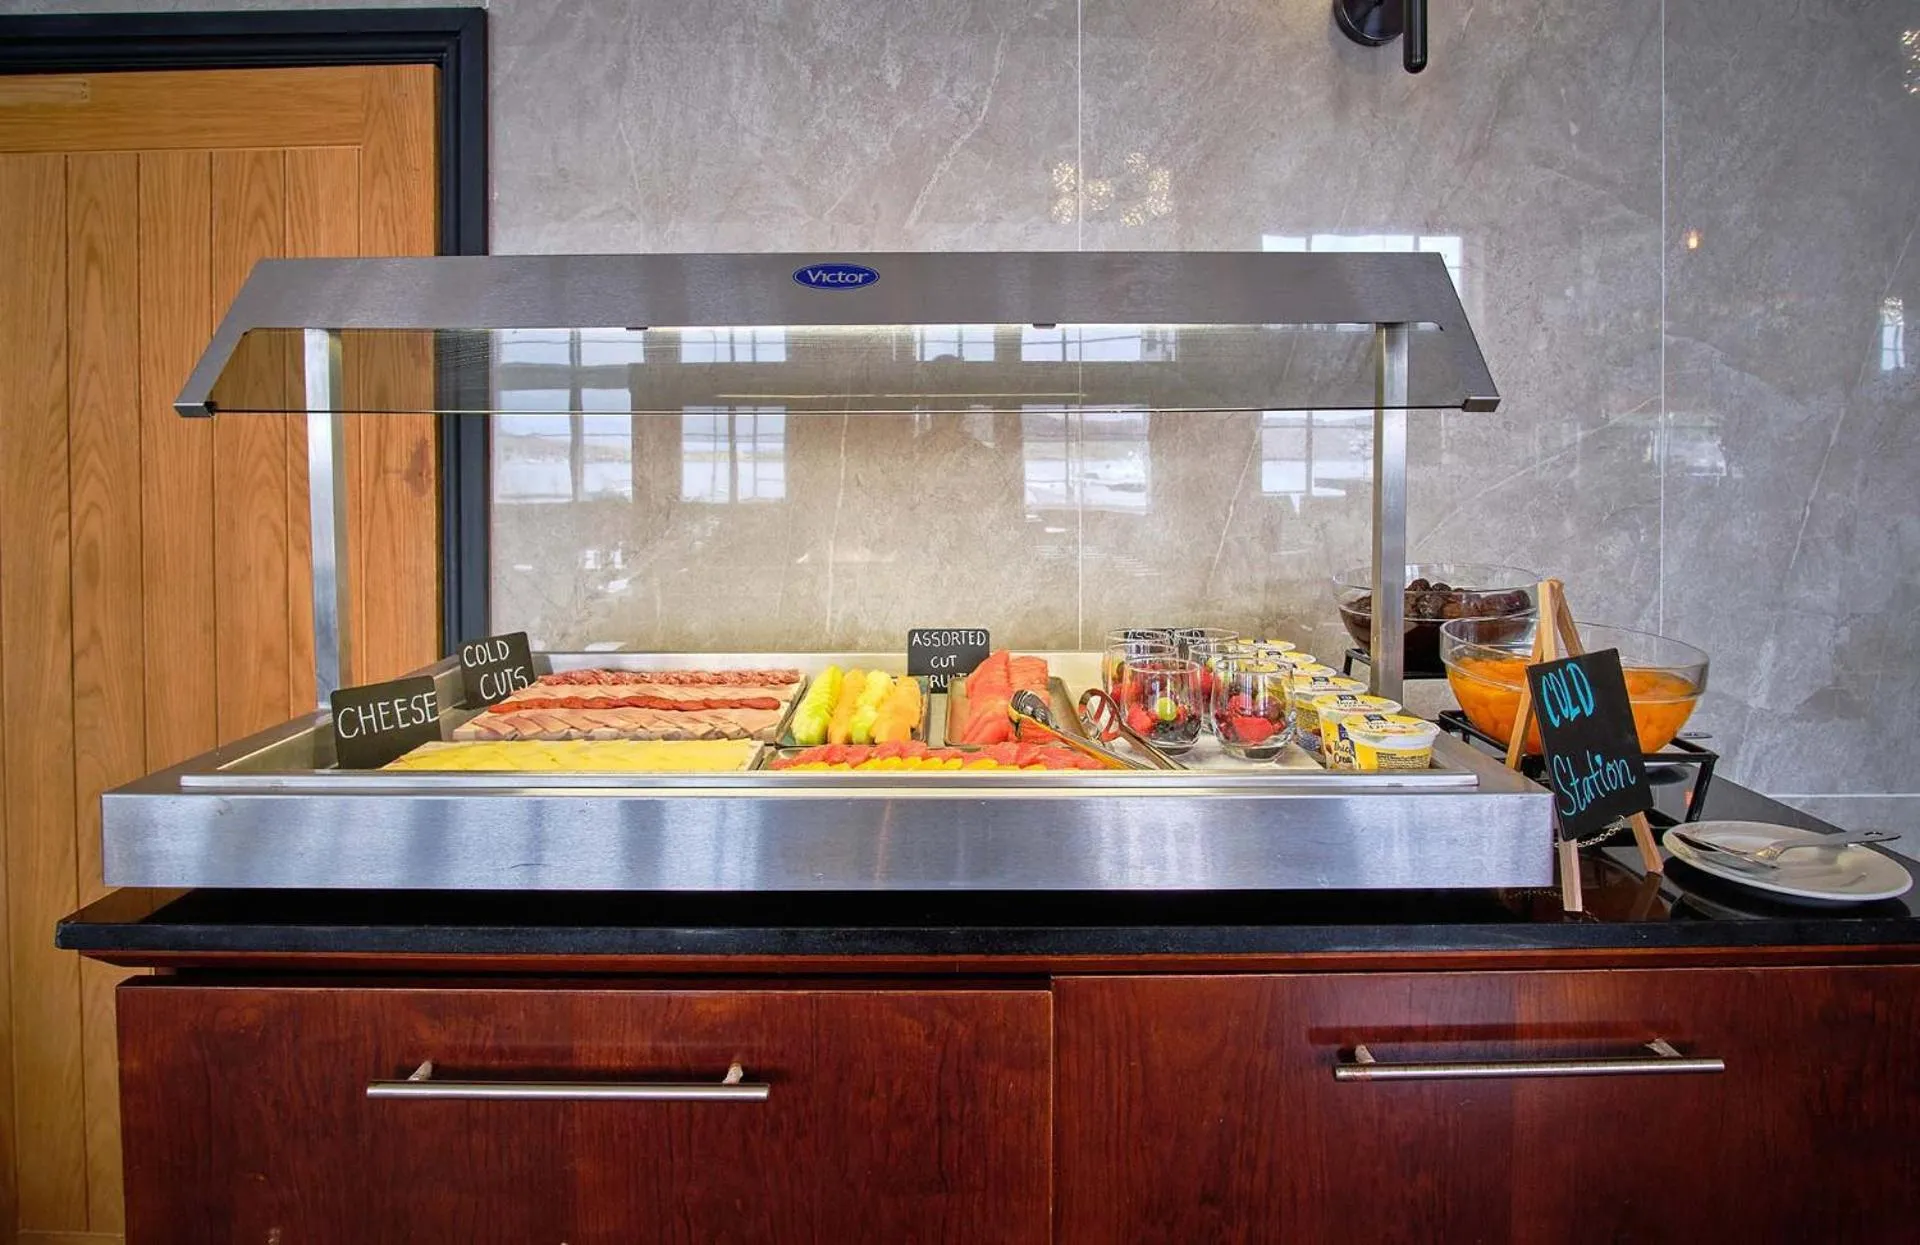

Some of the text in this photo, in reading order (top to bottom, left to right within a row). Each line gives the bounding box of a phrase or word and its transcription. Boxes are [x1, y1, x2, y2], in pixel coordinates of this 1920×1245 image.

[807, 269, 869, 284] Victor
[463, 640, 510, 668] COLD
[912, 630, 986, 647] ASSORTED
[930, 655, 957, 669] CUT
[479, 666, 529, 700] CUTS
[1540, 662, 1595, 728] COLD
[337, 690, 440, 739] CHEESE
[1552, 750, 1636, 817] Station
